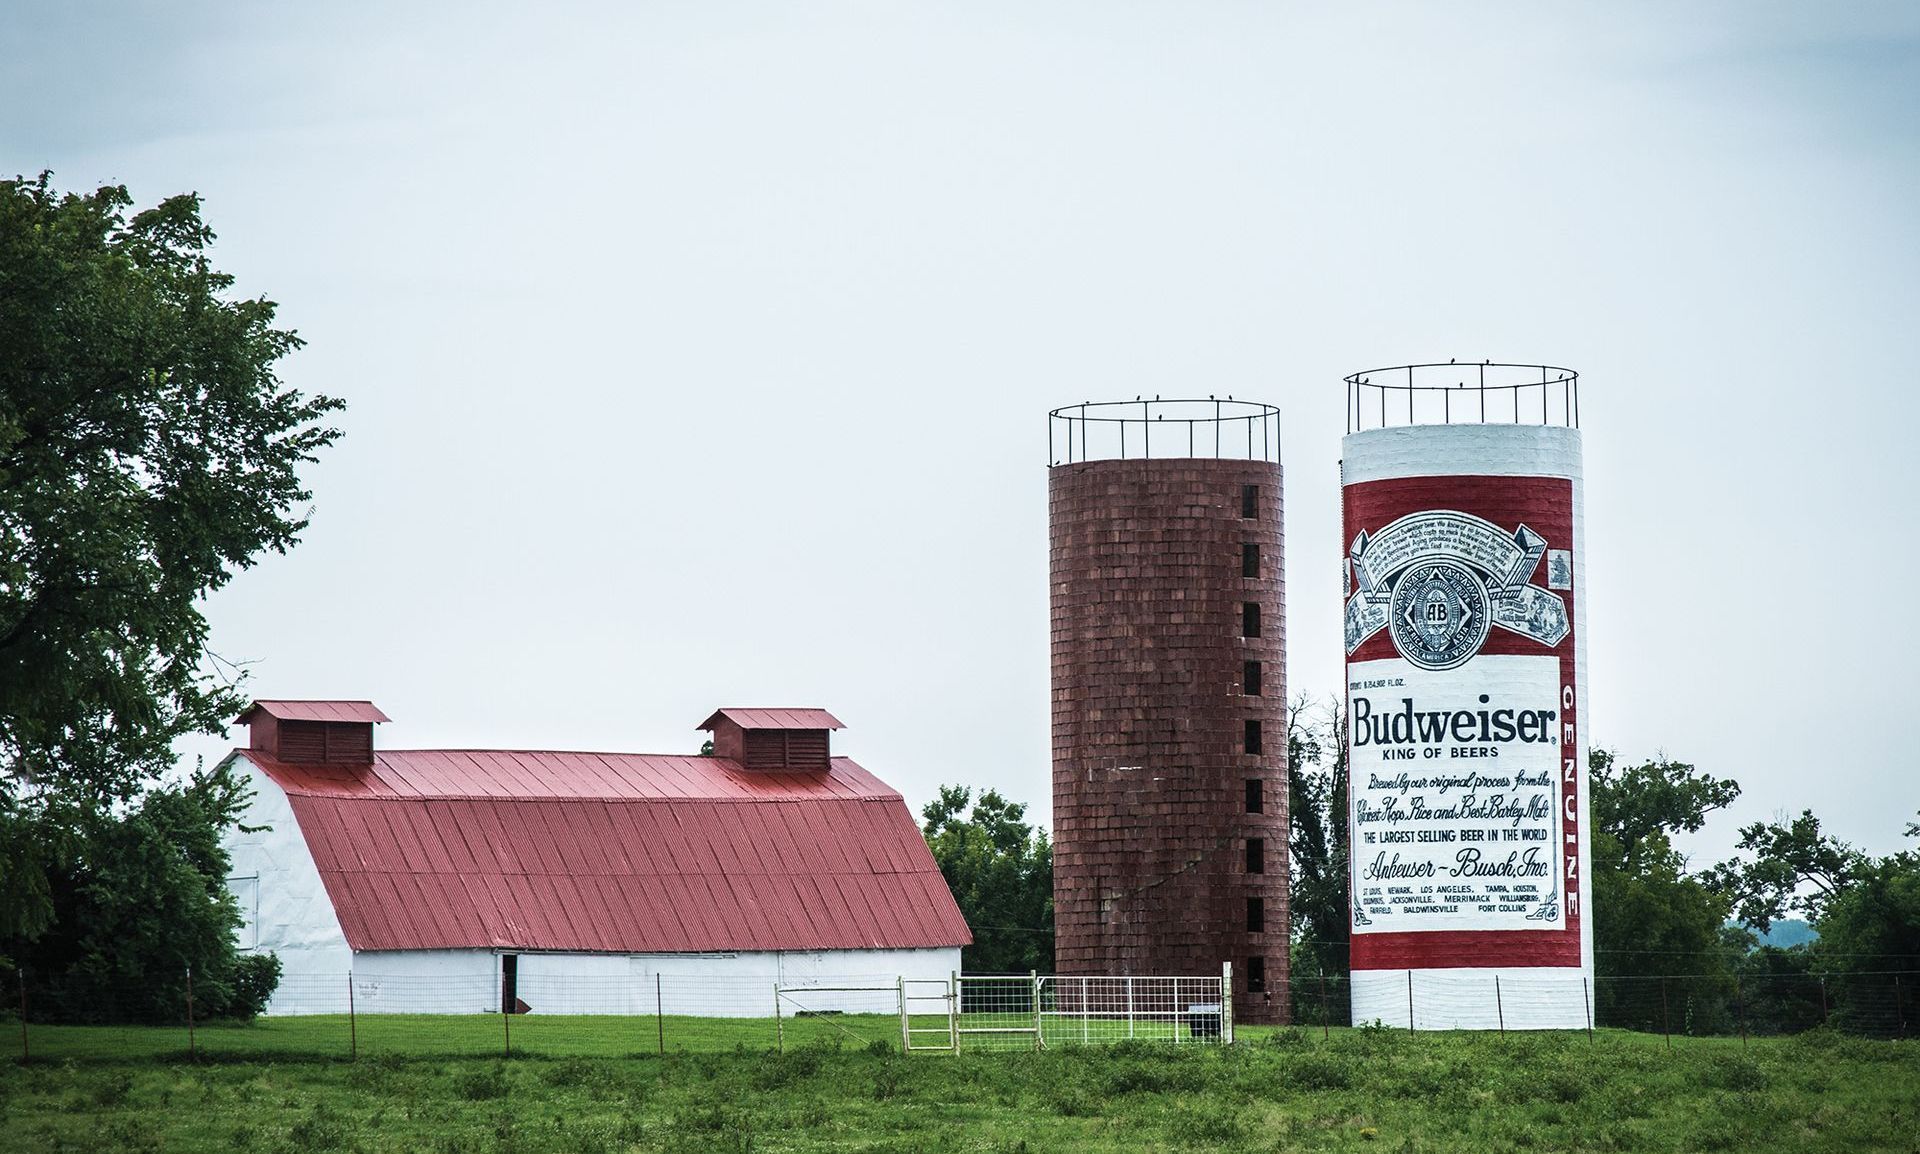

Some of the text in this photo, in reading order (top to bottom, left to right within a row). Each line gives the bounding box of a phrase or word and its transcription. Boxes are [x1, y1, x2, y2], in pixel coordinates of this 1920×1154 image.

[1450, 579, 1470, 604] EUROPE
[1428, 604, 1447, 621] AB
[1406, 625, 1424, 648] AFRICA
[1453, 626, 1469, 646] ASIA
[1353, 694, 1556, 747] Budweiser
[1382, 746, 1499, 760] KING OF BEERS
[1368, 769, 1550, 796] Brewed by our original process from the
[1404, 796, 1432, 820] Rice
[1434, 804, 1457, 820] and
[1457, 794, 1487, 819] Best
[1485, 794, 1524, 827] Barley
[1522, 794, 1549, 821] Malt
[1562, 684, 1578, 916] GENUINE
[1364, 828, 1548, 844] THE LARGEST SELLING BEER IN THE WORLD
[1362, 850, 1436, 881] Anheuser
[1516, 846, 1548, 877] Inc.
[1420, 886, 1433, 894] LOS
[1444, 894, 1490, 902] MERRIMACK
[1403, 905, 1458, 914] BALDWINSVILLE
[1478, 904, 1496, 912] FORT
[1498, 904, 1526, 912] COLLINS
